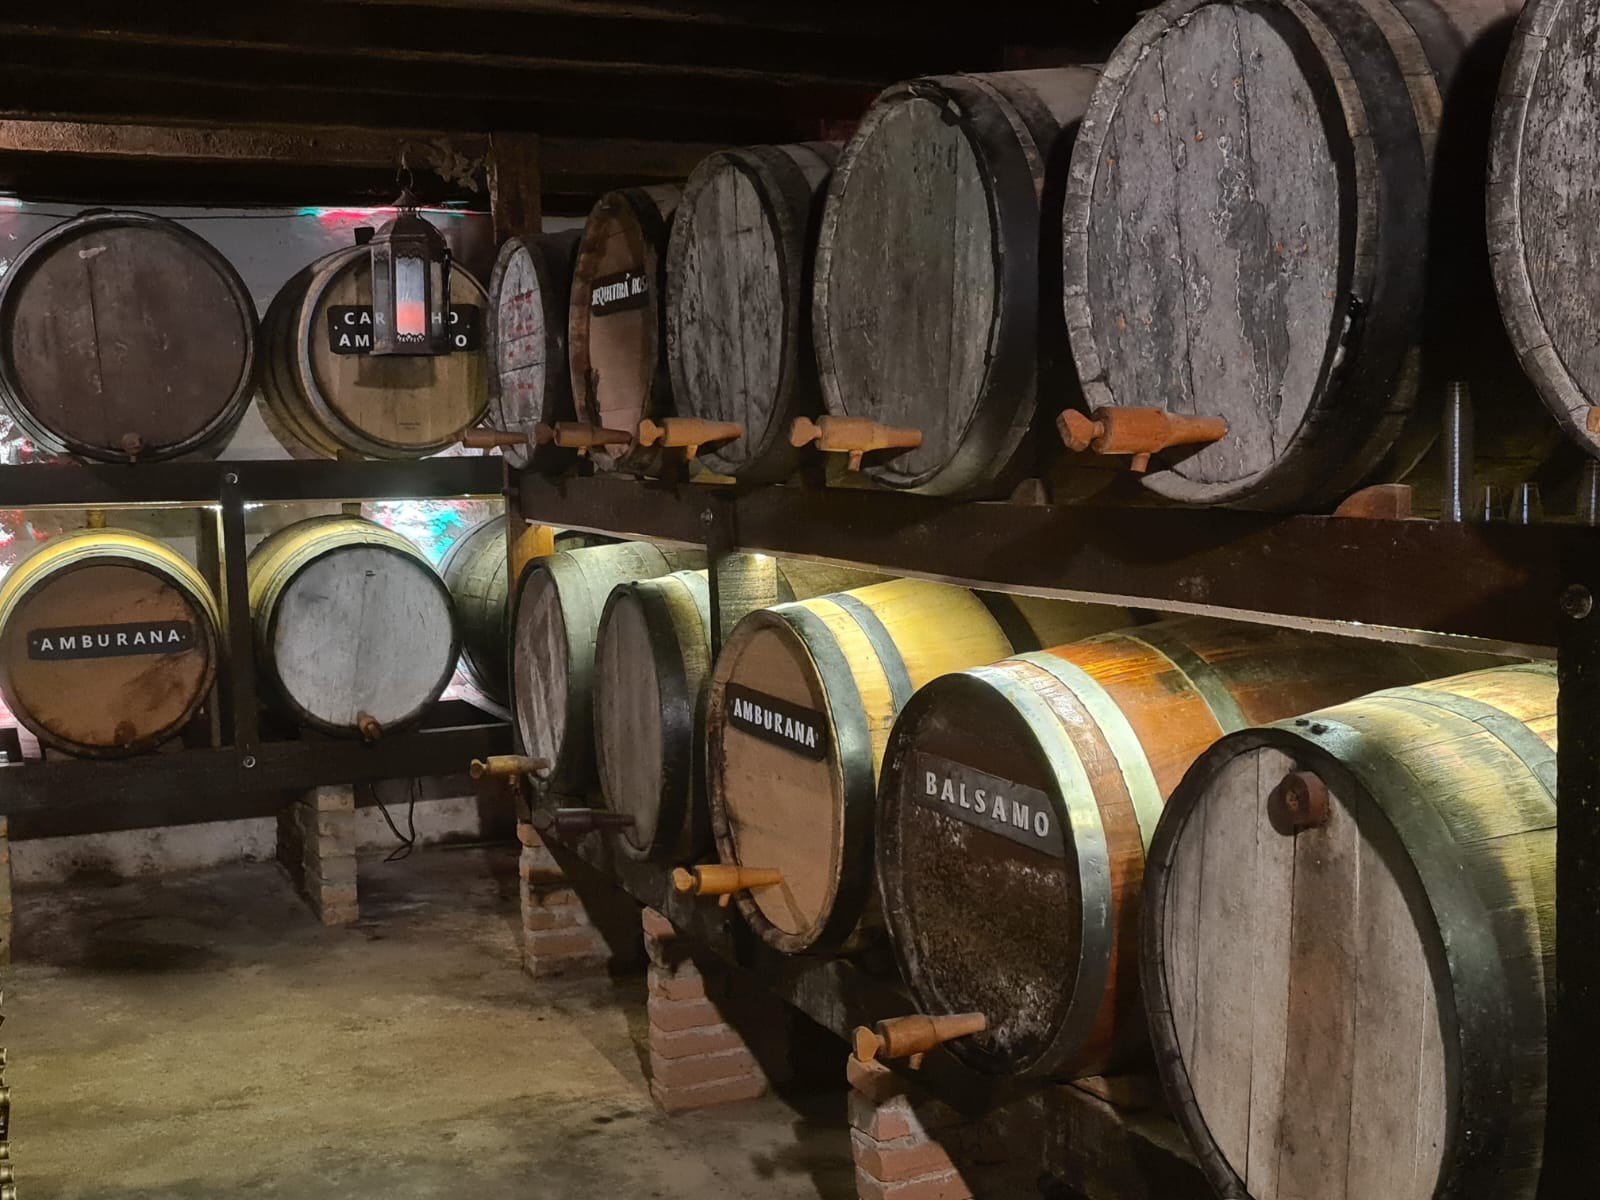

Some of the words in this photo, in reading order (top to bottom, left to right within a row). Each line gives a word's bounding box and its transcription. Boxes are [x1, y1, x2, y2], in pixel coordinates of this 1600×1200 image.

[344, 312, 459, 325] CARHO
[41, 629, 180, 651] AMBURANA
[733, 698, 815, 748] AMBURANA
[925, 771, 1049, 837] BALSAMO
